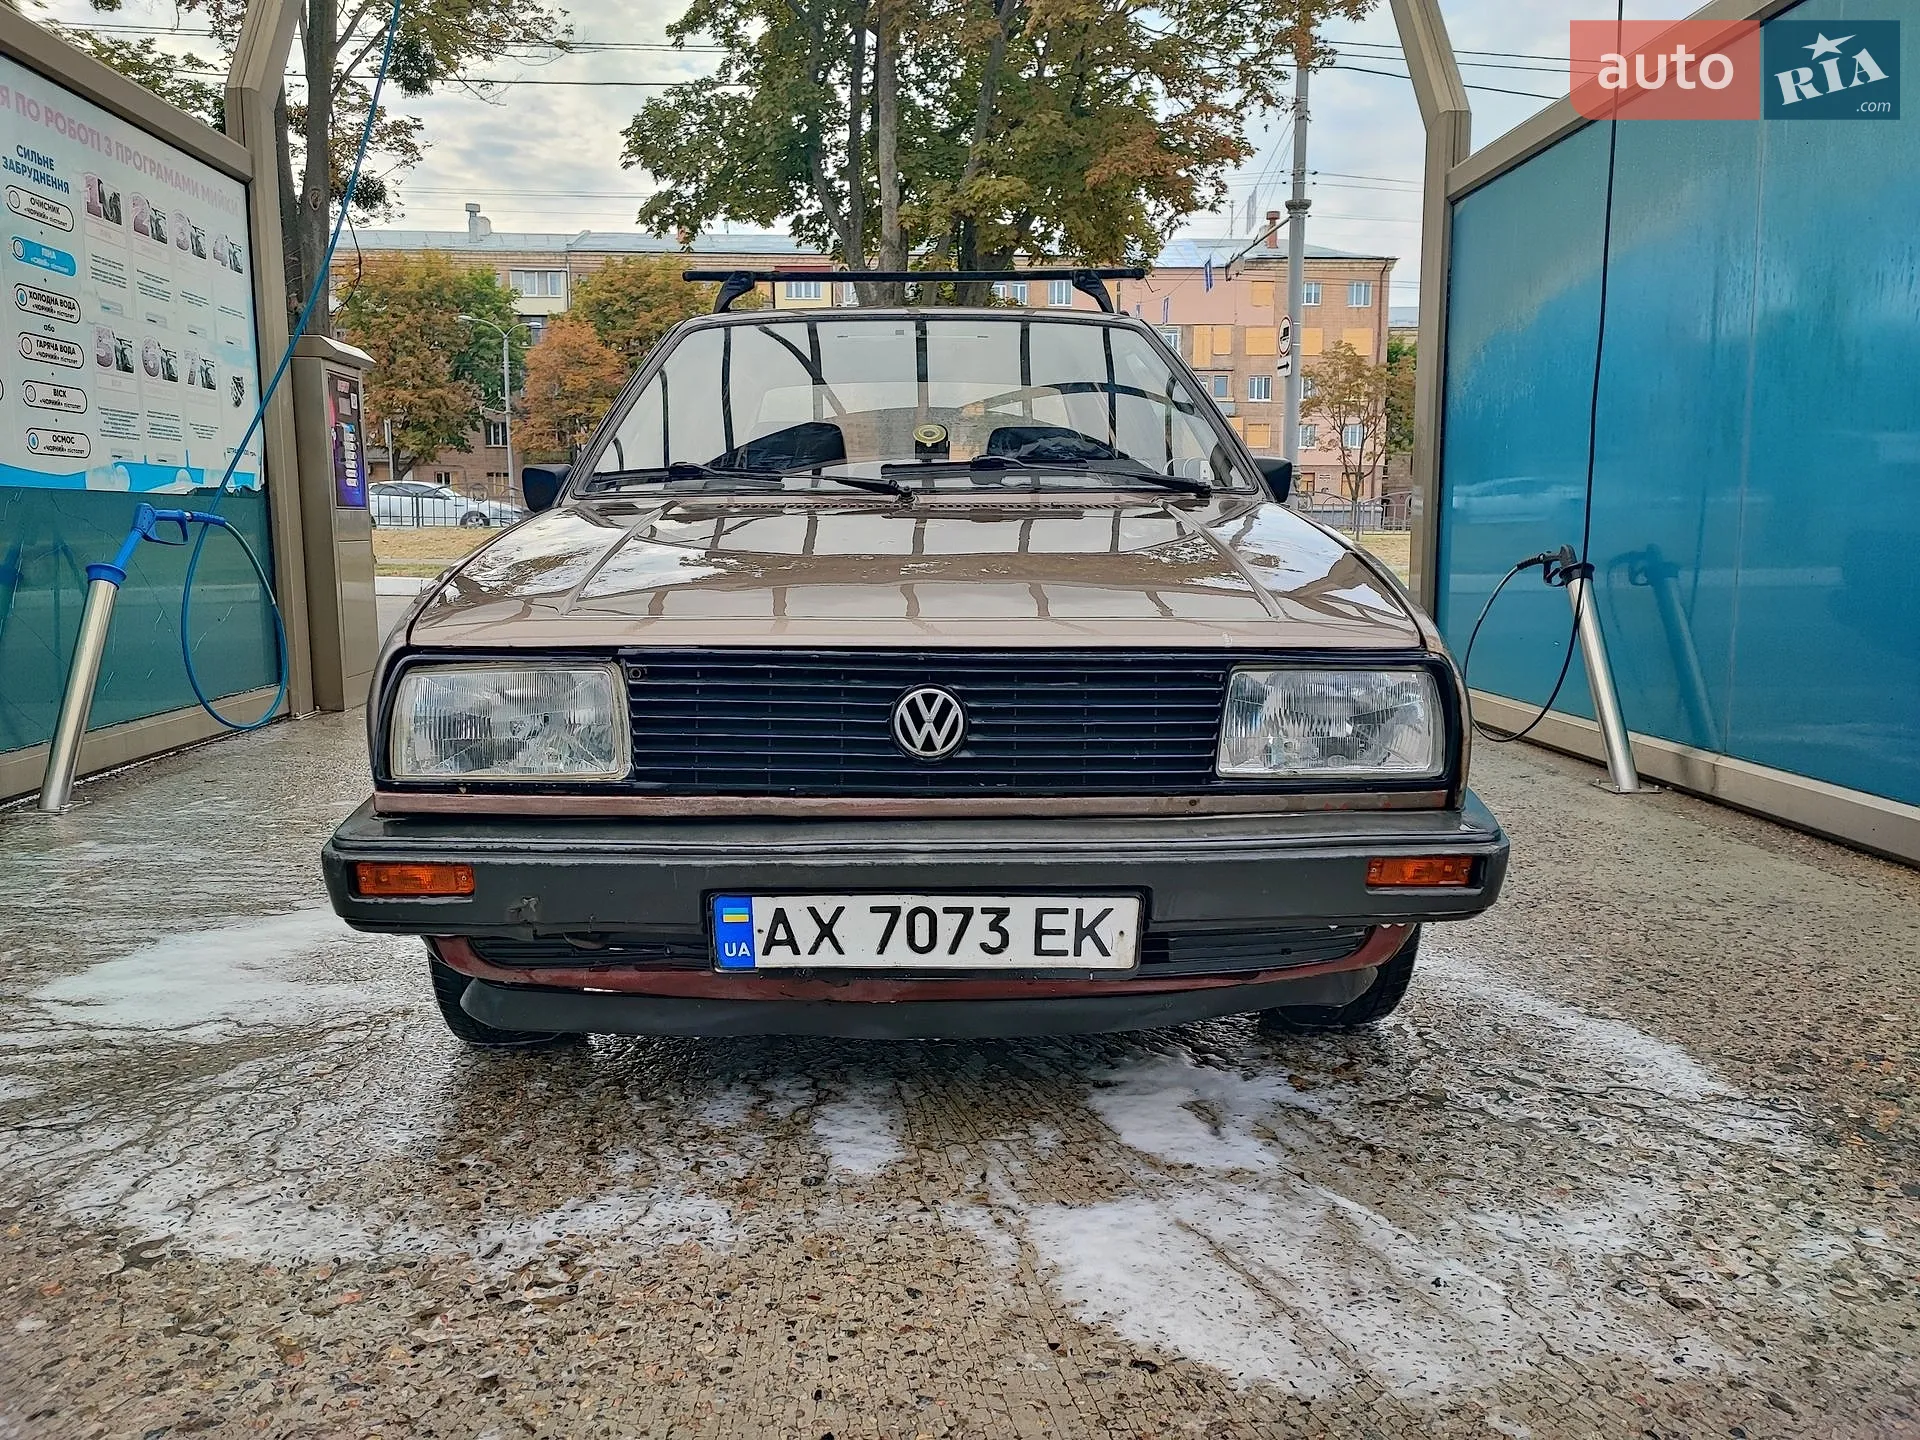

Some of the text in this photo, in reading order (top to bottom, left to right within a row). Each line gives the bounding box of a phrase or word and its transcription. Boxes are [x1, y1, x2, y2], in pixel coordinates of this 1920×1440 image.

[14, 90, 41, 121] ПО
[44, 105, 101, 152] РОБОТІ
[114, 140, 199, 199] ПРОГРАМАМИ
[16, 144, 55, 171] СИЛЬНЕ
[2, 156, 70, 195] ЗАБРУДНЕННЯ
[30, 197, 60, 215] ОЧИСНИК
[29, 290, 77, 311] ХОЛОДНА ВОДА
[43, 323, 55, 332] або
[36, 340, 77, 356] ГАРЯЧА ВОДА
[53, 388, 67, 398] ВІСК
[52, 434, 75, 445] ОСМОС
[761, 904, 1115, 958] AX 7073 EK
[723, 941, 752, 959] UA
